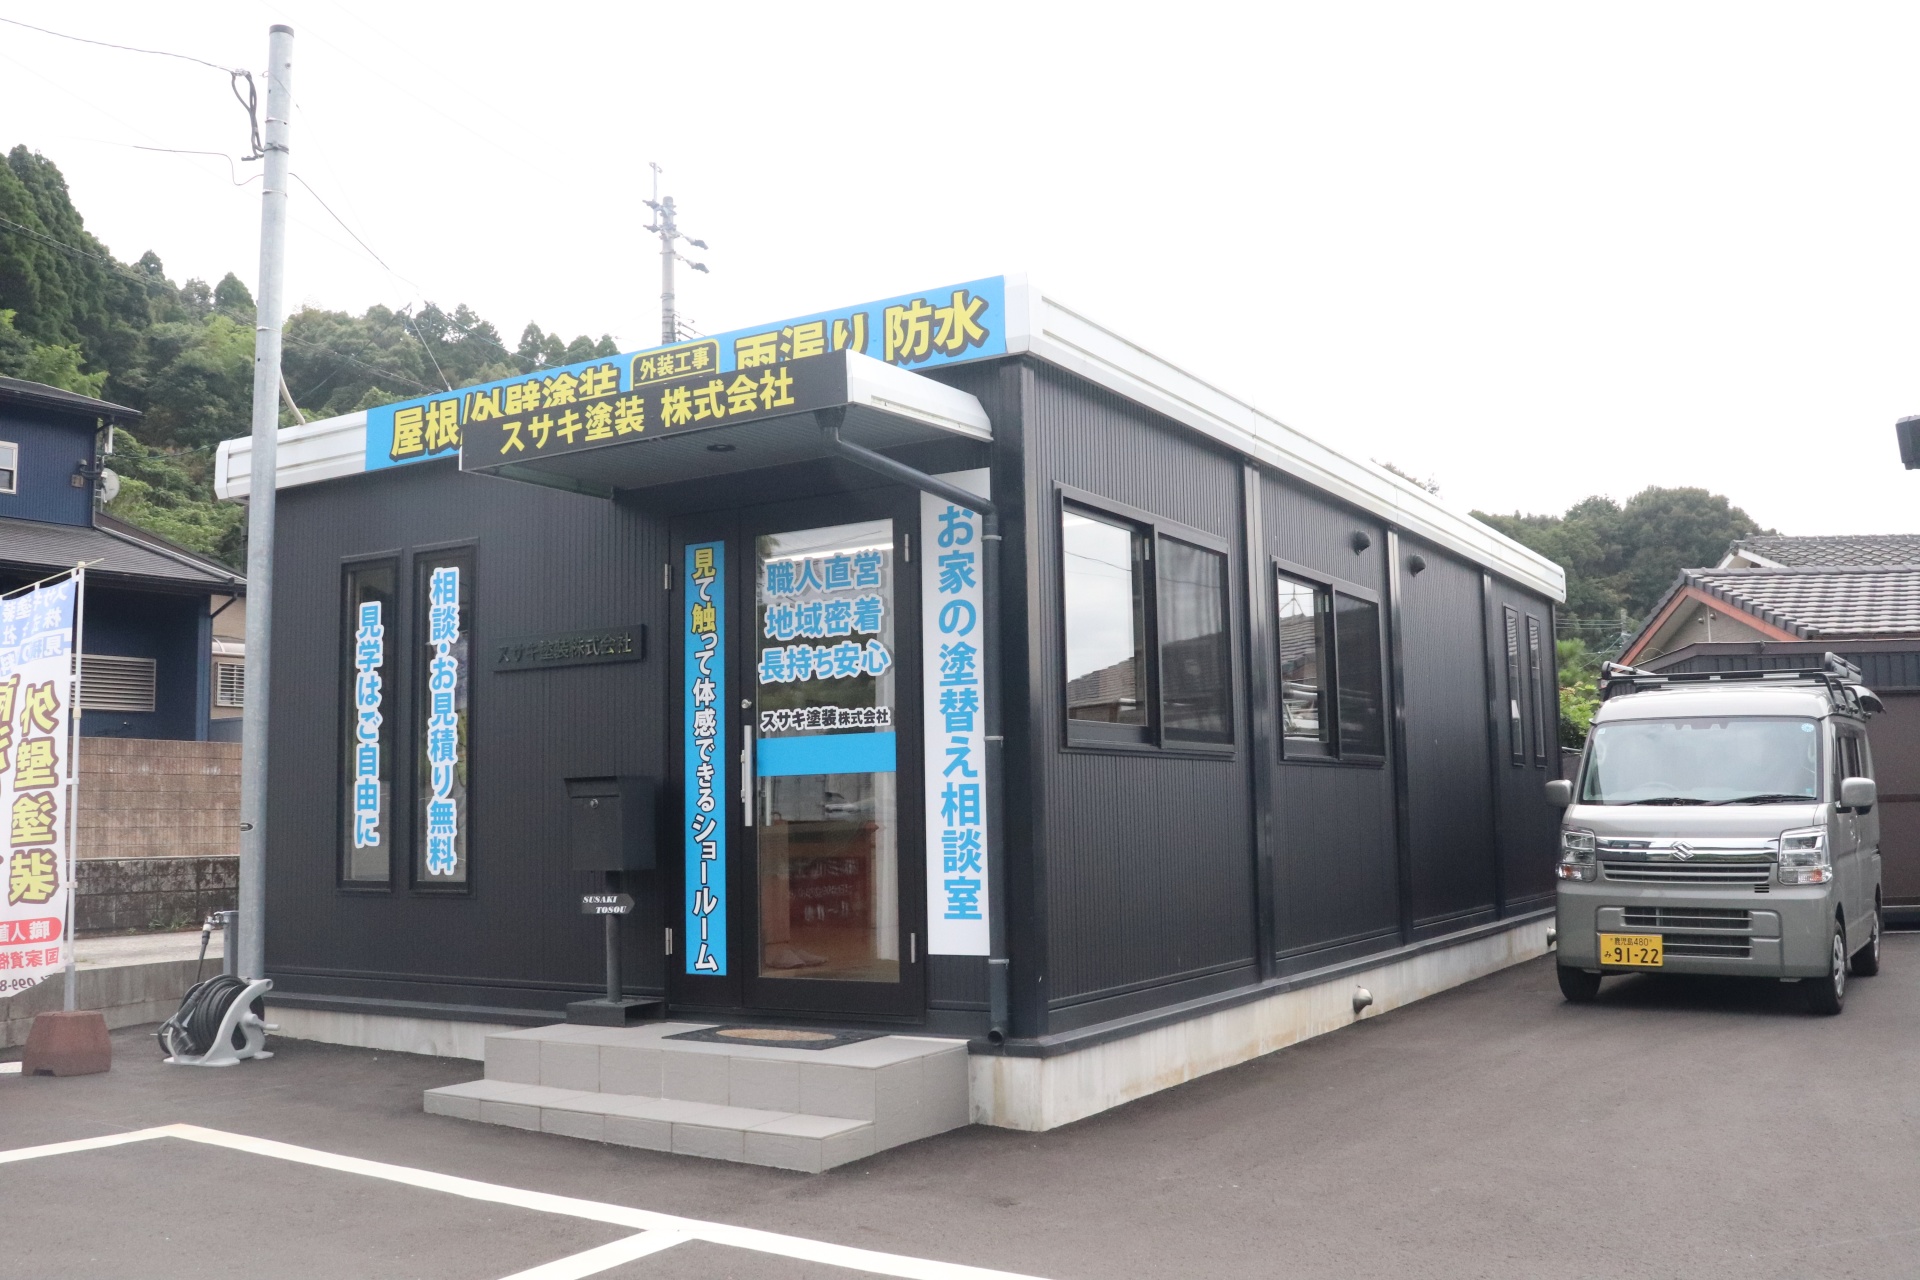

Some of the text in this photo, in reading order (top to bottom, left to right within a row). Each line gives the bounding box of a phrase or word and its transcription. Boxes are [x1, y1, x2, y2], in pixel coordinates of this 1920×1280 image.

[884, 290, 988, 363] 防水
[640, 348, 711, 380] 外装工事
[500, 367, 795, 456] スサキ塗装 株式会社
[766, 551, 883, 596] 職人直営
[765, 597, 883, 640] 地域密着
[497, 631, 632, 664] スサキ塗装株式会社
[758, 640, 891, 683] 長持ち安心
[356, 602, 384, 847] 見学はご自由に
[430, 568, 459, 874] 相談・お見積り無料
[760, 707, 890, 730] スサキ塗装 株式会社
[937, 506, 983, 921] お家の塗替え相談室
[691, 547, 719, 974] 見て触って体感できるショールーム
[1614, 947, 1659, 964] 91-22
